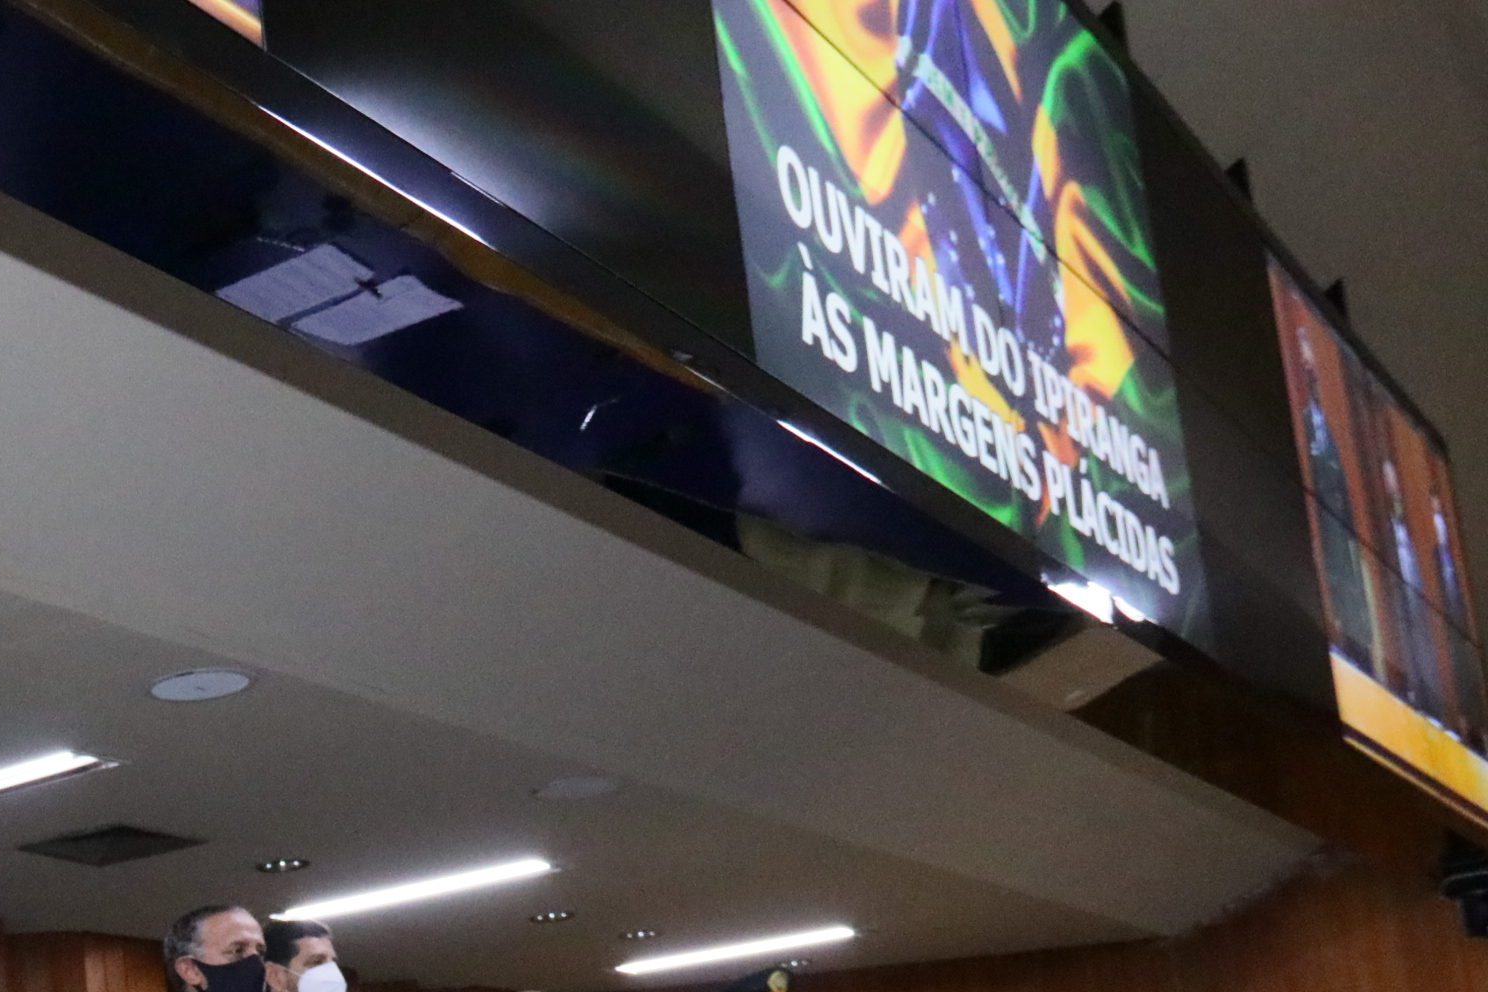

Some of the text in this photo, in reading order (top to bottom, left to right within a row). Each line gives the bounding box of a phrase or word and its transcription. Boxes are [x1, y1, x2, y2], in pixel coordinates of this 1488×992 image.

[777, 145, 970, 355] OUVIRAM
[972, 303, 1025, 396] DO
[1028, 350, 1170, 509] IPIRANGA
[801, 241, 1180, 595] ÀS MARGENS PLÁCIDAS
